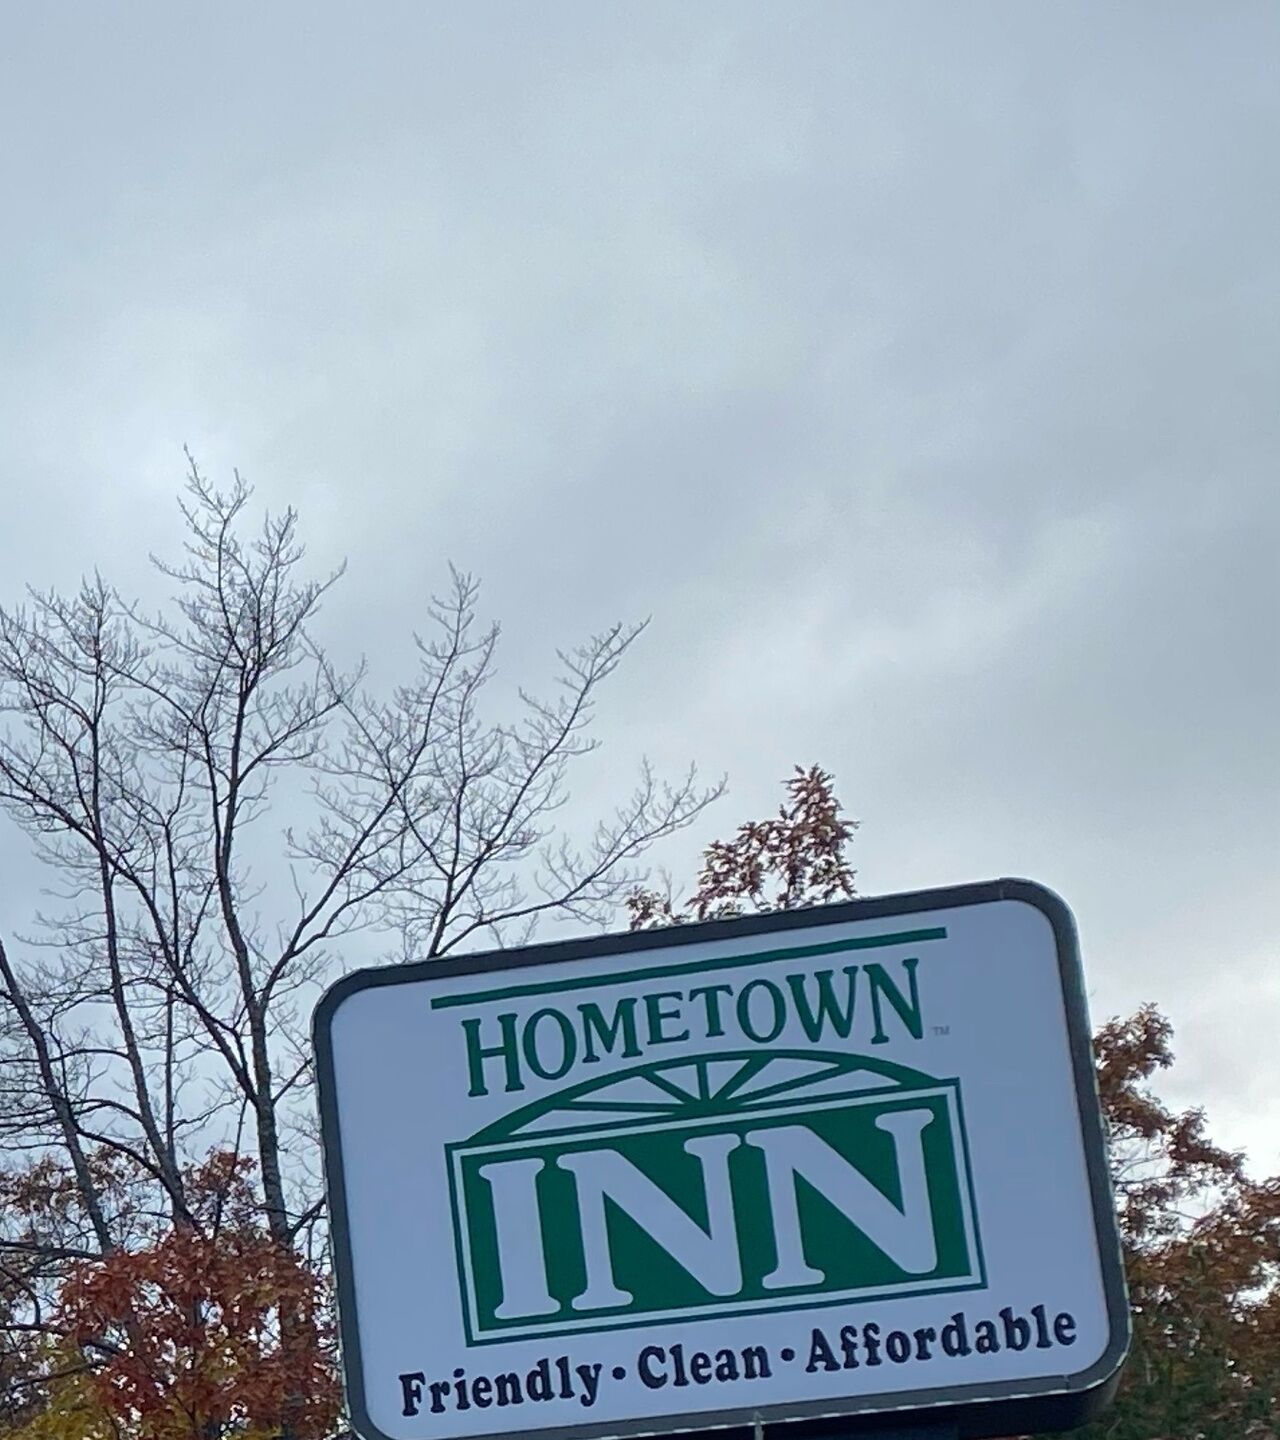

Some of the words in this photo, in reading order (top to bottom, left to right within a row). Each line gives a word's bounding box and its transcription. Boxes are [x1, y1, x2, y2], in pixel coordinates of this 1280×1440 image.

[461, 957, 924, 1097] HOMETOWN
[479, 1109, 936, 1319] INN
[398, 1356, 603, 1417] Friendly
[637, 1344, 773, 1389] Clean
[805, 1304, 1077, 1373] Affordable
